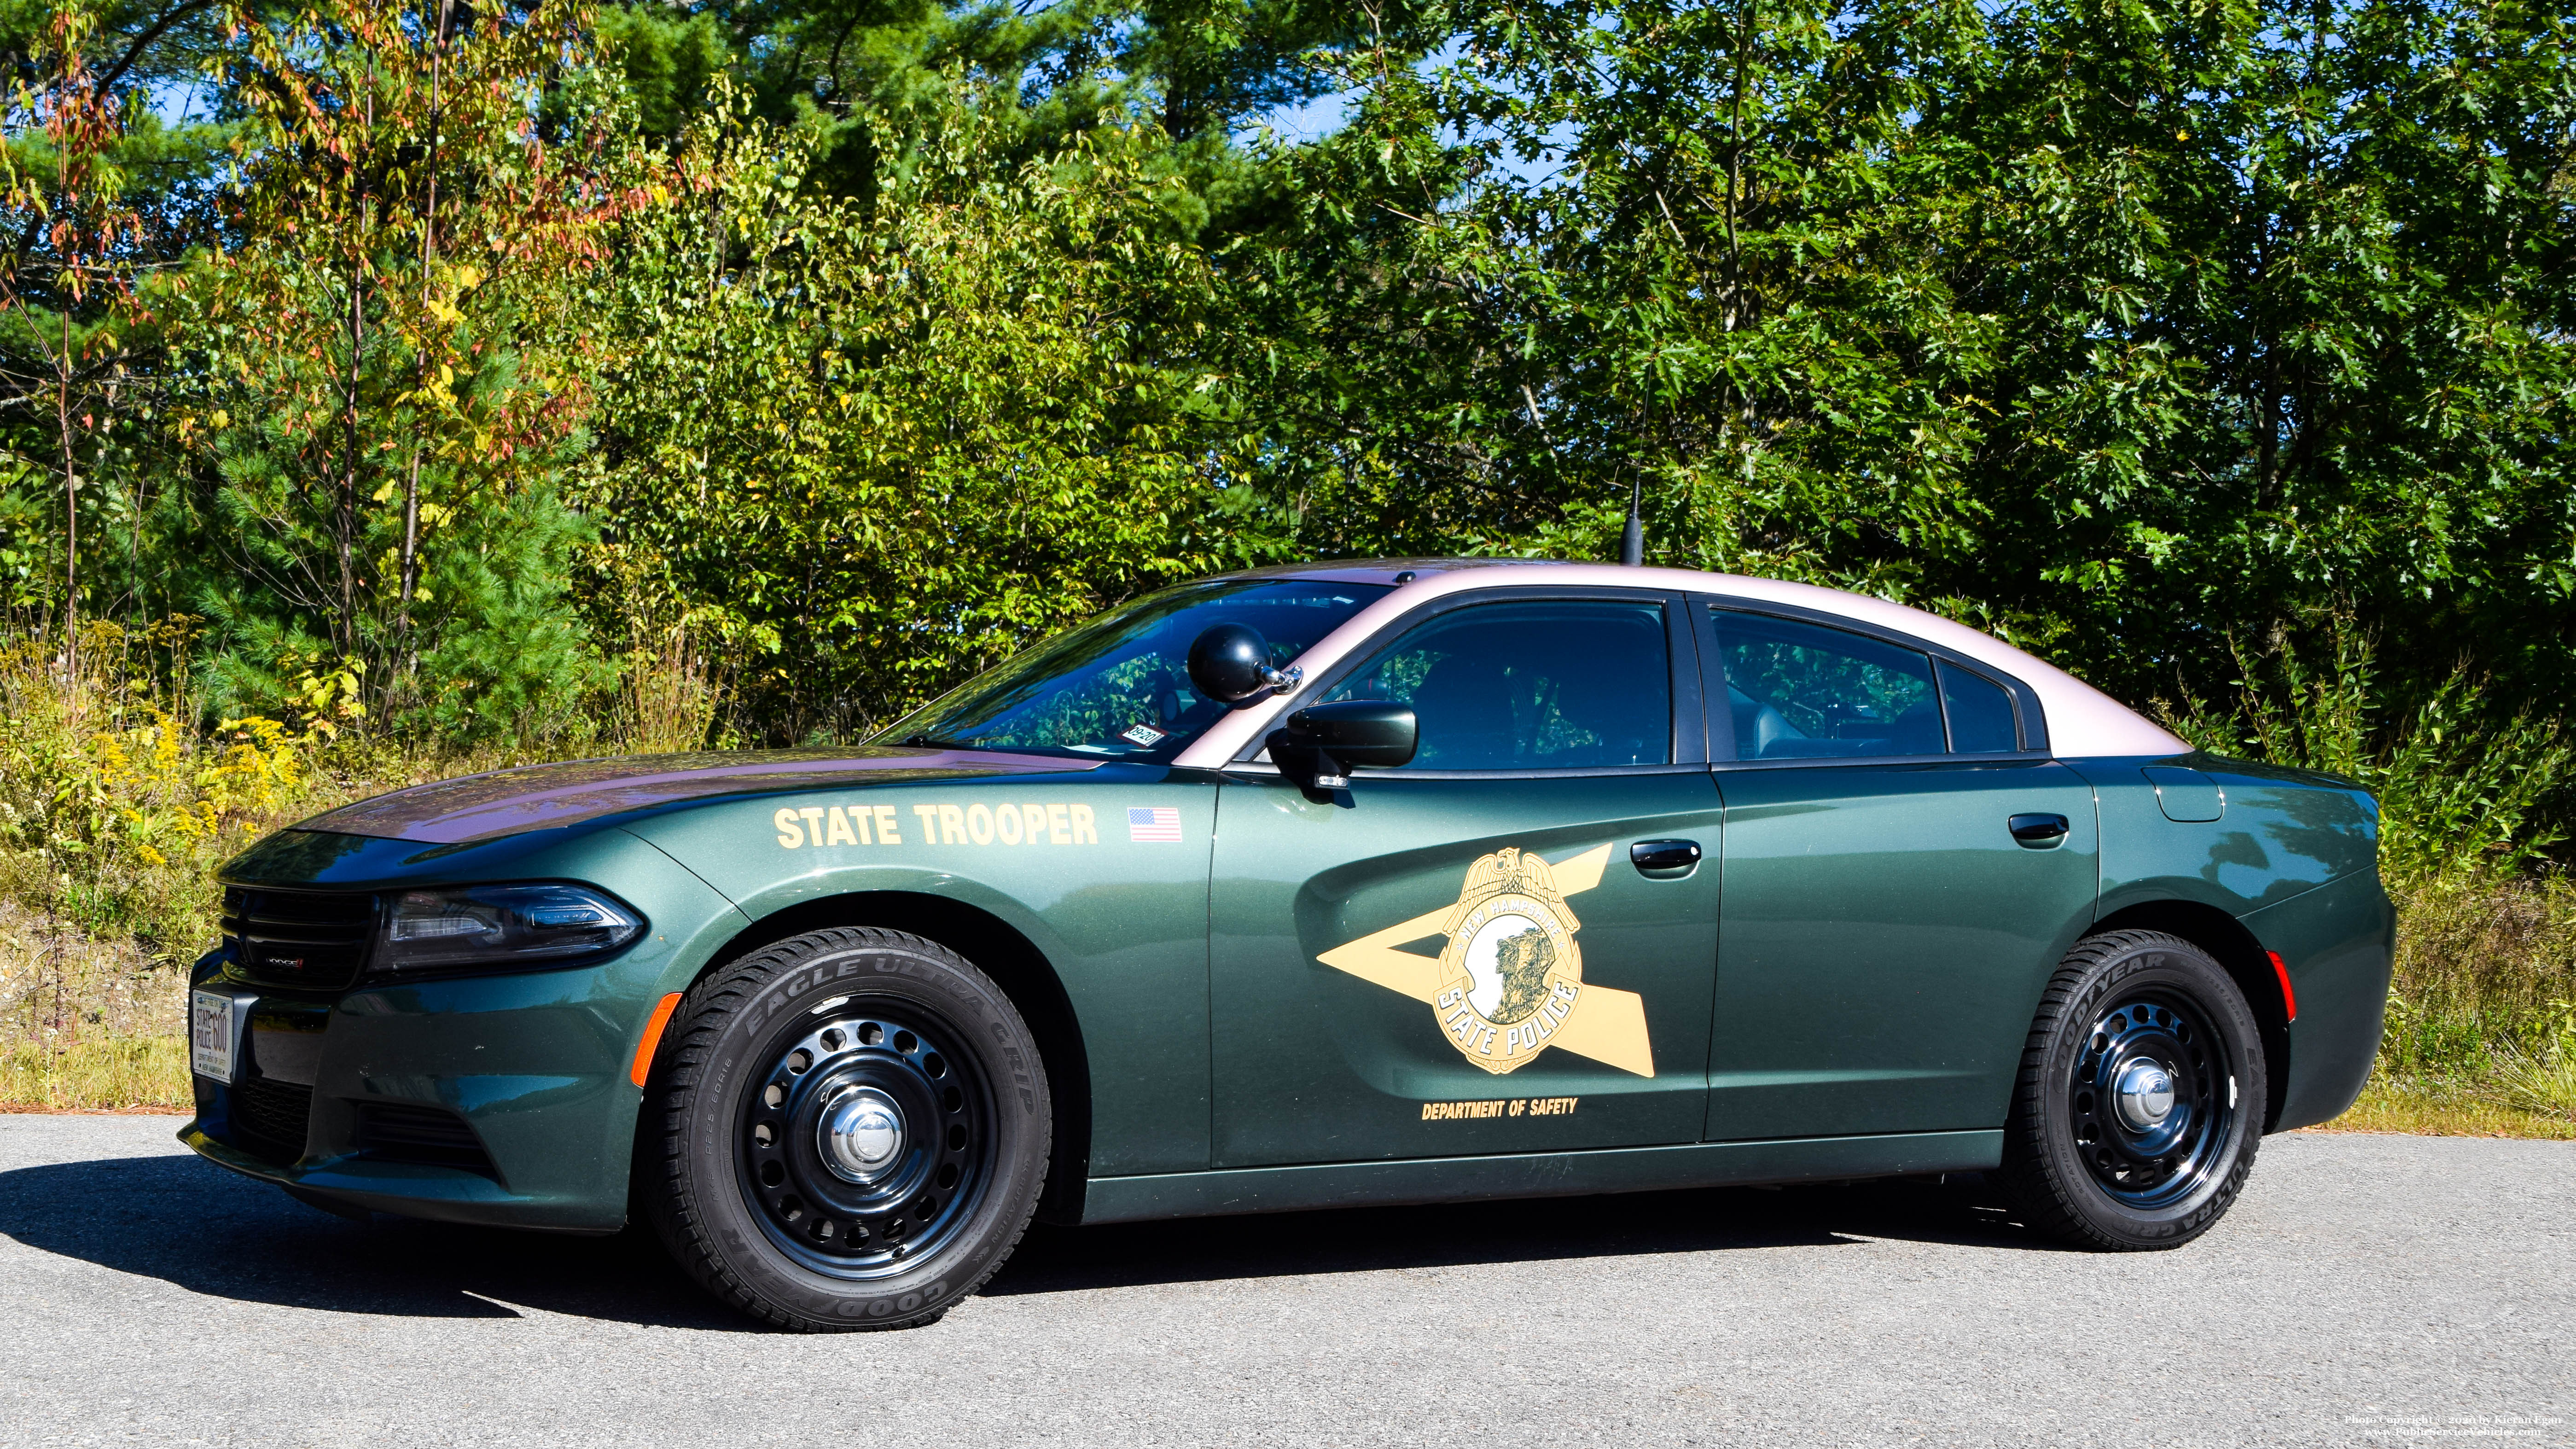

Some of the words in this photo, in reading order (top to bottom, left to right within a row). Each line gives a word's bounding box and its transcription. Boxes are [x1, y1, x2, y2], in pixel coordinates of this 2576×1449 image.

[1128, 727, 1156, 741] 09-20
[774, 805, 901, 849] STATE
[913, 803, 1099, 845] TROOPER
[1460, 909, 1486, 940] NEW
[1490, 898, 1561, 939] HAMPSHIRE
[266, 958, 299, 967] DODGE
[197, 1008, 211, 1029] STATE
[212, 1013, 227, 1053] 600
[745, 958, 861, 1037] EAGLE
[874, 957, 995, 1014] ULTRA
[991, 1022, 1036, 1115] GRIP
[1438, 987, 1497, 1055] STATE
[1506, 981, 1578, 1055] POLICE
[196, 1029, 211, 1050] POLICE
[1422, 1100, 1505, 1120] DEPARTMENT
[1508, 1100, 1526, 1117] OF
[1529, 1097, 1578, 1116] SAFETY
[2182, 1161, 2244, 1230] ULTRA
[721, 1227, 948, 1318] GOODYEAR
